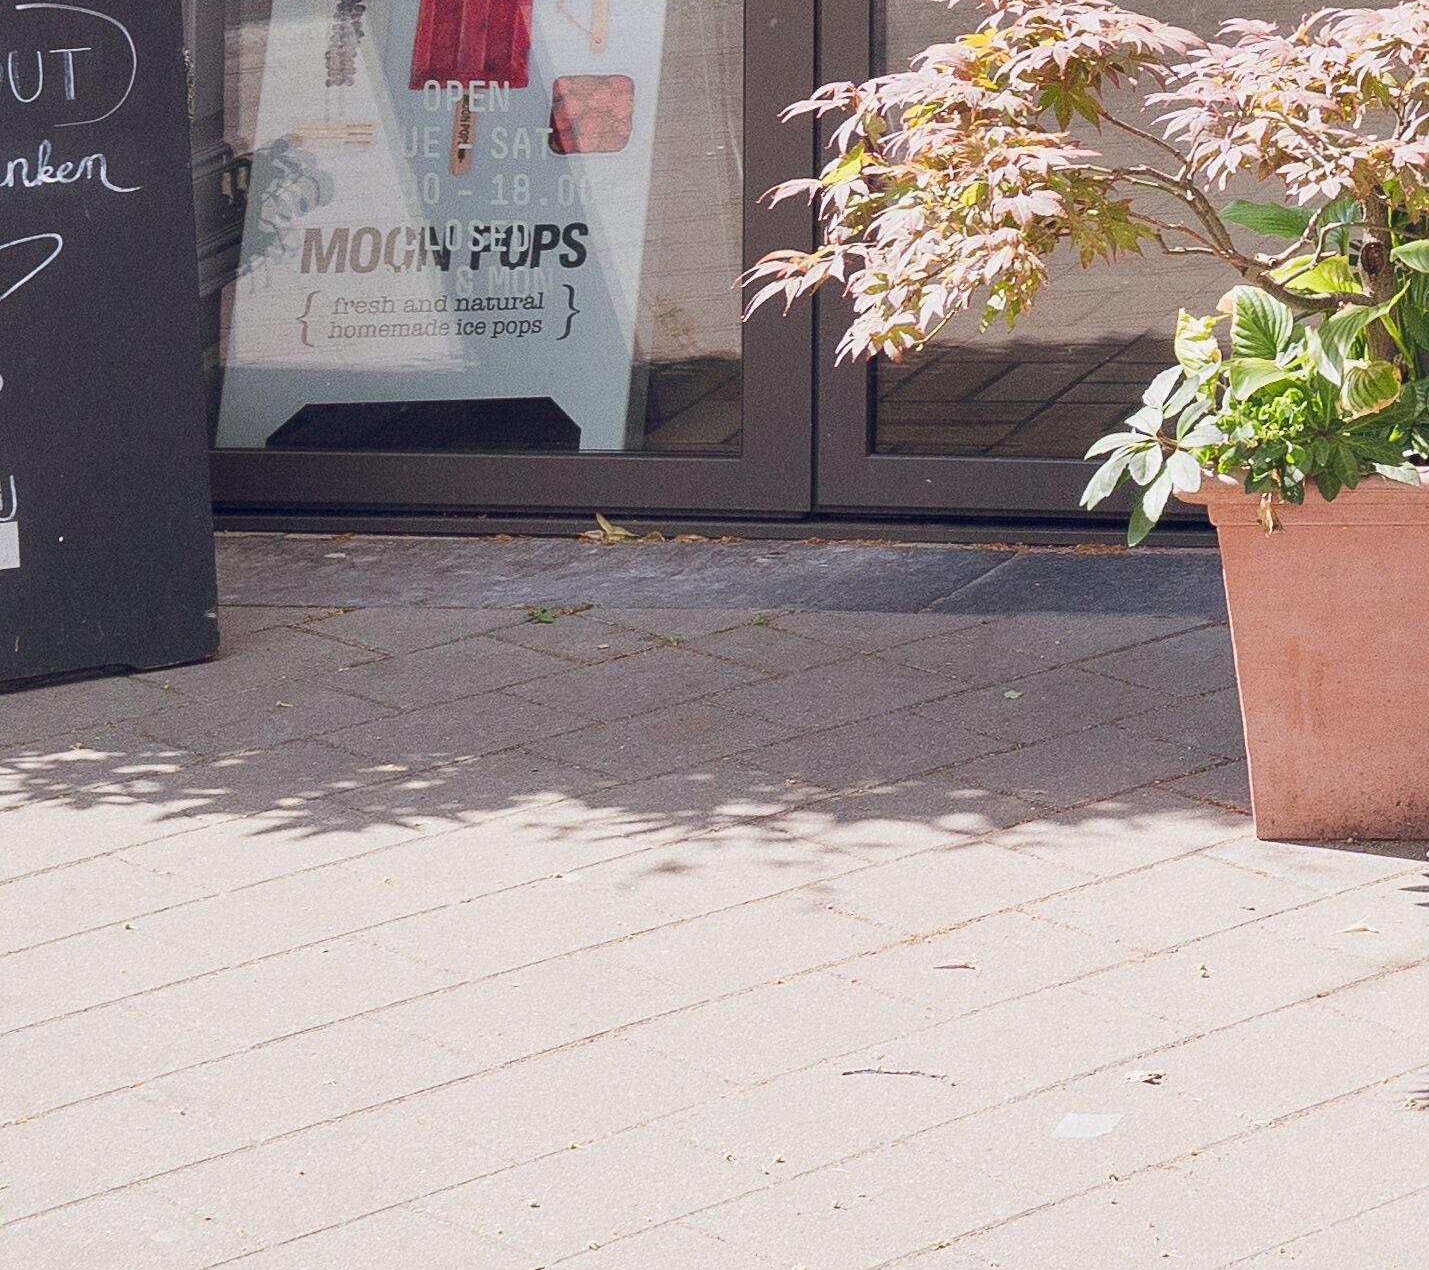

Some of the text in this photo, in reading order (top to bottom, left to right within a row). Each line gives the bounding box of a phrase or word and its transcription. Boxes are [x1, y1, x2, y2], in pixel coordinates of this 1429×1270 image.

[0, 46, 92, 104] UT
[423, 79, 511, 113] OPEN
[0, 139, 142, 193] nken
[299, 221, 590, 275] MOON POPS
[330, 291, 545, 315] fresh and natural
[327, 317, 543, 340] homemade ice pops
